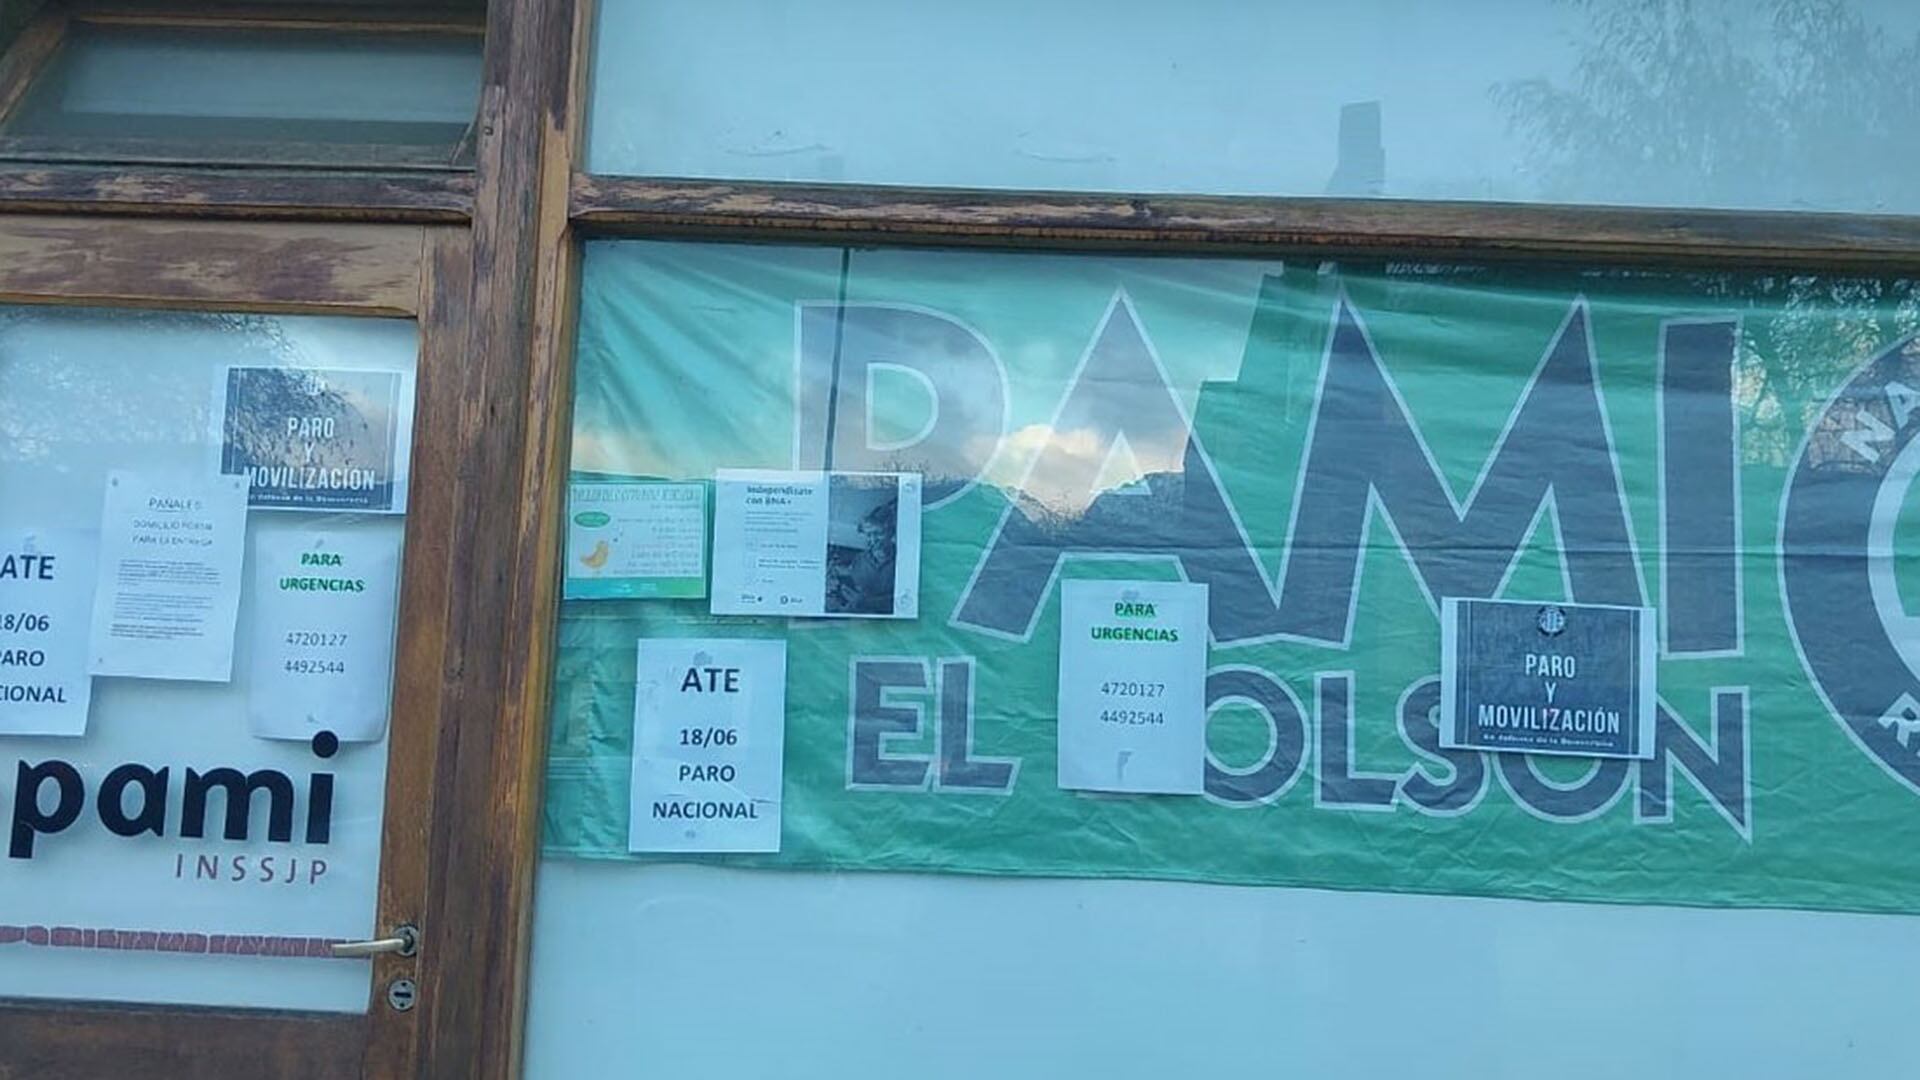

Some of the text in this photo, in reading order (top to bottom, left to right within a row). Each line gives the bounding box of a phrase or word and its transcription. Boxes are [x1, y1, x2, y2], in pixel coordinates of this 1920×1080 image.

[287, 416, 335, 439] PARO
[304, 442, 315, 463] Y
[793, 286, 1742, 660] PAMI
[0, 554, 55, 580] ATE
[301, 553, 342, 566] PARA
[280, 578, 366, 592] URGENCIAS
[1114, 603, 1156, 616] PARA
[286, 632, 348, 647] 4720127
[1091, 627, 1178, 641] URGENCIAS
[0, 649, 45, 667] ARO
[284, 661, 345, 674] 4492544
[1525, 653, 1576, 679] PARO
[680, 667, 740, 693] ATE
[1101, 682, 1165, 698] 4720127
[1544, 681, 1557, 704] Y
[847, 655, 1022, 795] EL
[1100, 710, 1164, 725] 4492544
[1477, 704, 1620, 734] MOVILIZACIÓN
[680, 728, 738, 748] 18/06
[679, 765, 736, 782] PARO
[9, 731, 339, 859] pami
[652, 802, 759, 819] NACIONAL
[175, 854, 328, 884] INSSJP
